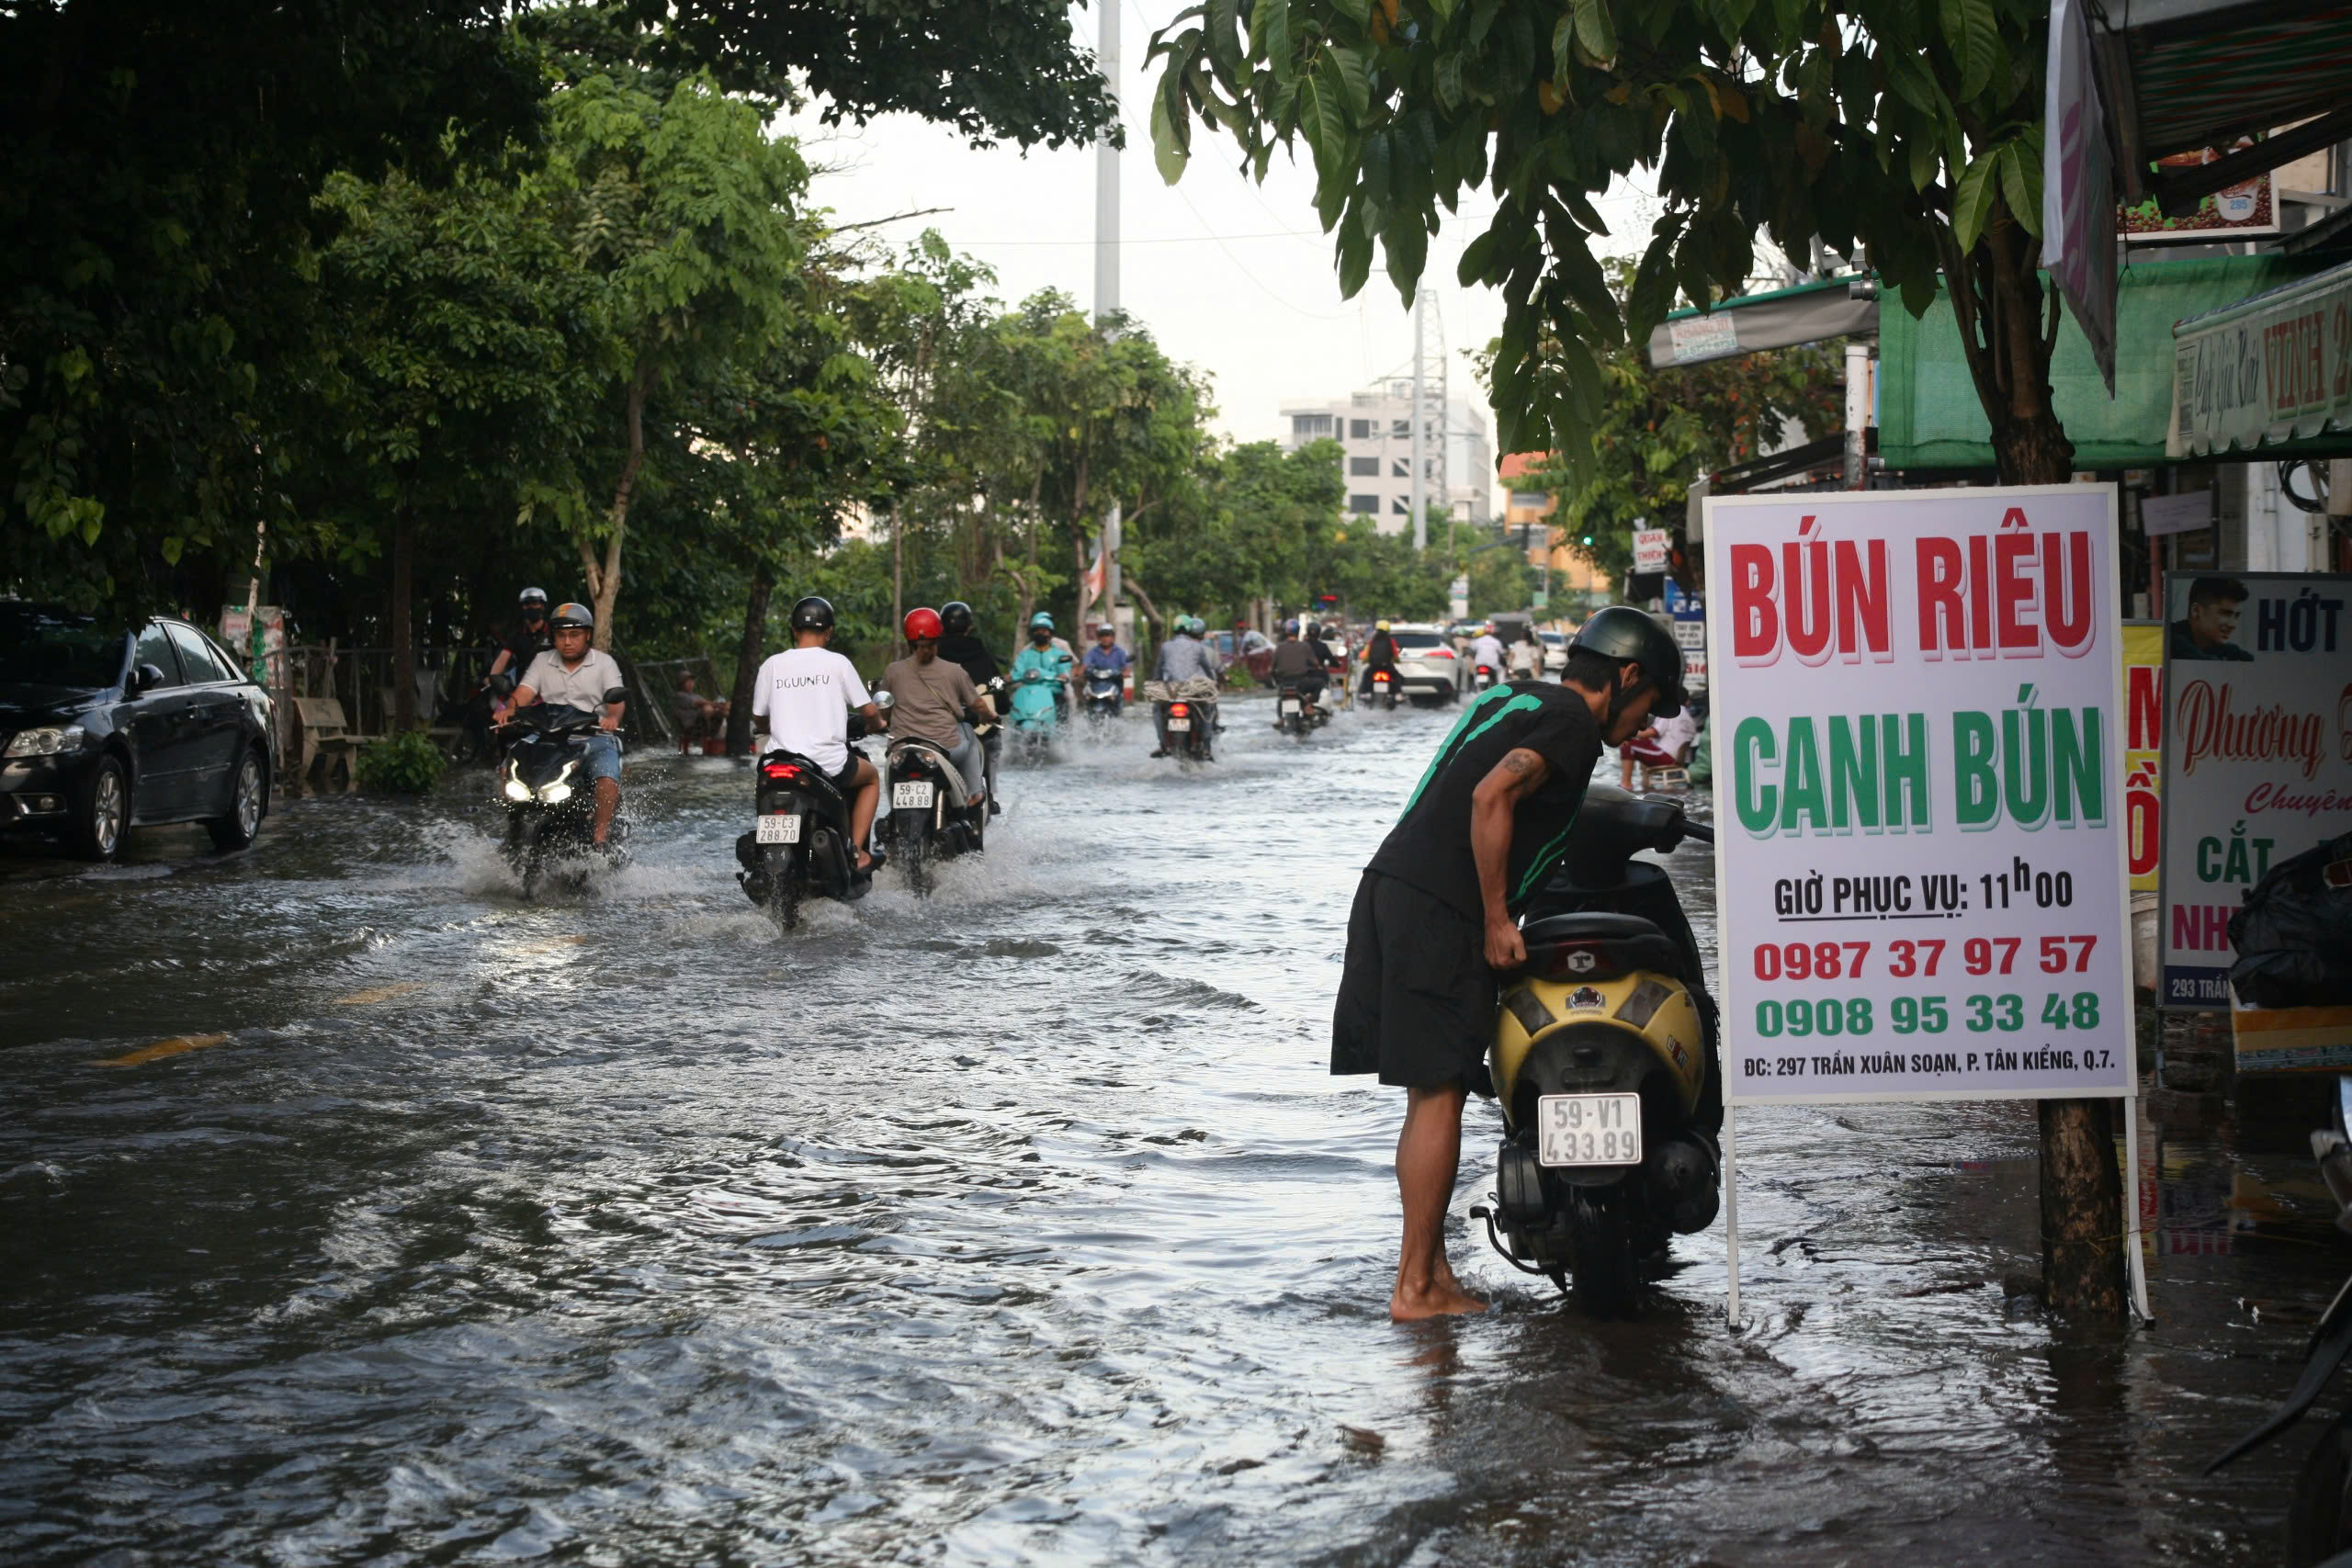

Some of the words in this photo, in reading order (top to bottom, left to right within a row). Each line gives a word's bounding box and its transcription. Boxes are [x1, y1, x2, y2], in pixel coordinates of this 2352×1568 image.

[1731, 515, 1894, 668] BÚN
[1916, 507, 2096, 662] RIÊU
[2257, 587, 2344, 652] HỚT
[2177, 679, 2326, 782] Phương
[1734, 714, 1932, 840] CANH
[1952, 683, 2107, 833] BÚN
[899, 784, 927, 795] 59-C2
[760, 829, 796, 841] 288.70
[764, 817, 794, 829] 59-C3
[2197, 819, 2275, 884] CẮT
[1774, 869, 1824, 915] GIỜ
[1833, 875, 1911, 920] PHỤC
[1921, 874, 1968, 919] VỤ:
[1753, 941, 1871, 981] 0987
[1888, 939, 1946, 978] 37
[1963, 937, 2021, 976] 97
[2040, 934, 2098, 974] 57
[2172, 979, 2196, 998] 293
[1755, 998, 1873, 1038] 0908
[1891, 995, 1949, 1034] 95
[1965, 993, 2024, 1032] 33
[2041, 991, 2100, 1031] 48
[1744, 1058, 1772, 1077] ĐC:
[1776, 1058, 1805, 1077] 297
[1812, 1048, 1855, 1076] TRẦN
[1860, 1051, 1906, 1075] XUÂN
[1911, 1053, 1962, 1077] SOẠN,
[1966, 1053, 1980, 1072] P.
[1984, 1048, 2018, 1071] TÂN
[2022, 1043, 2079, 1072] KIỂNG,
[2083, 1050, 2116, 1070] Q.7.
[1554, 1099, 1622, 1130] 59-V1
[1546, 1131, 1635, 1161] 433.89
